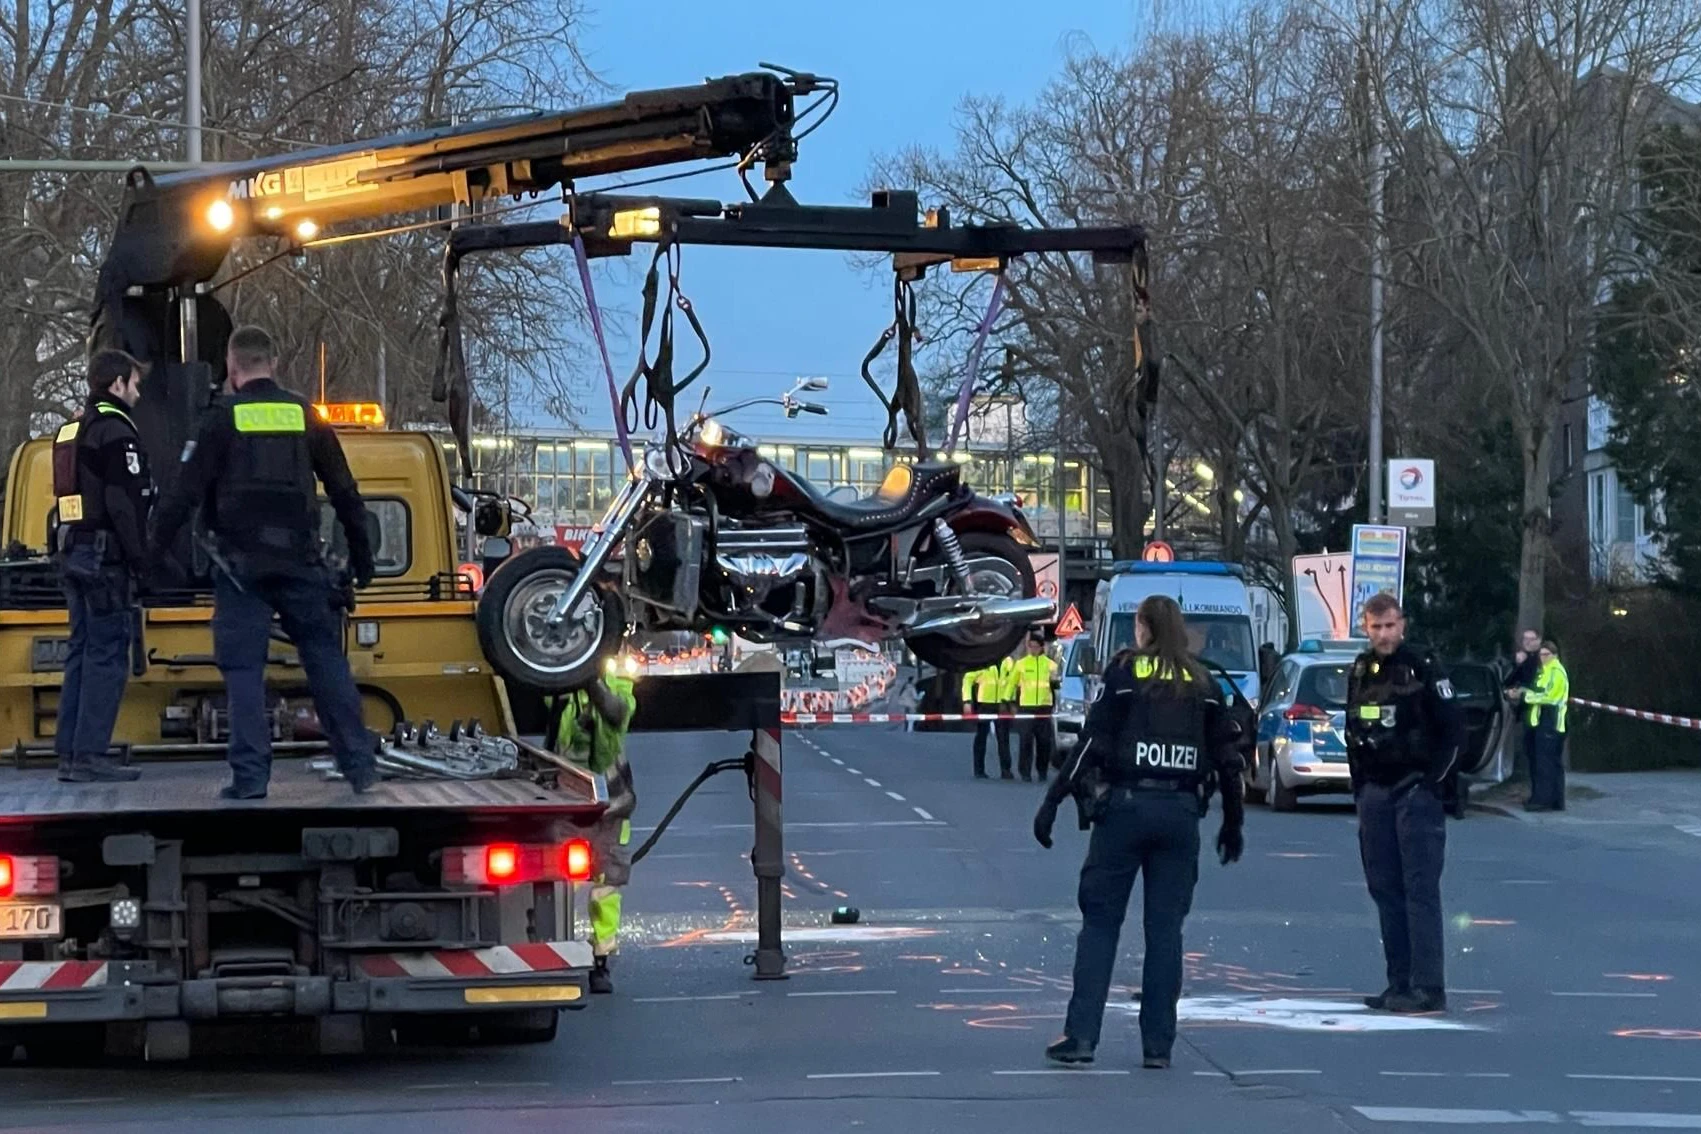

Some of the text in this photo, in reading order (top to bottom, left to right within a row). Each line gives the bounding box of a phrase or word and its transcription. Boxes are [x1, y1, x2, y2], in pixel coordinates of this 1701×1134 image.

[226, 171, 281, 201] MKG
[1136, 741, 1197, 770] POLIZEI
[6, 907, 50, 931] 170
